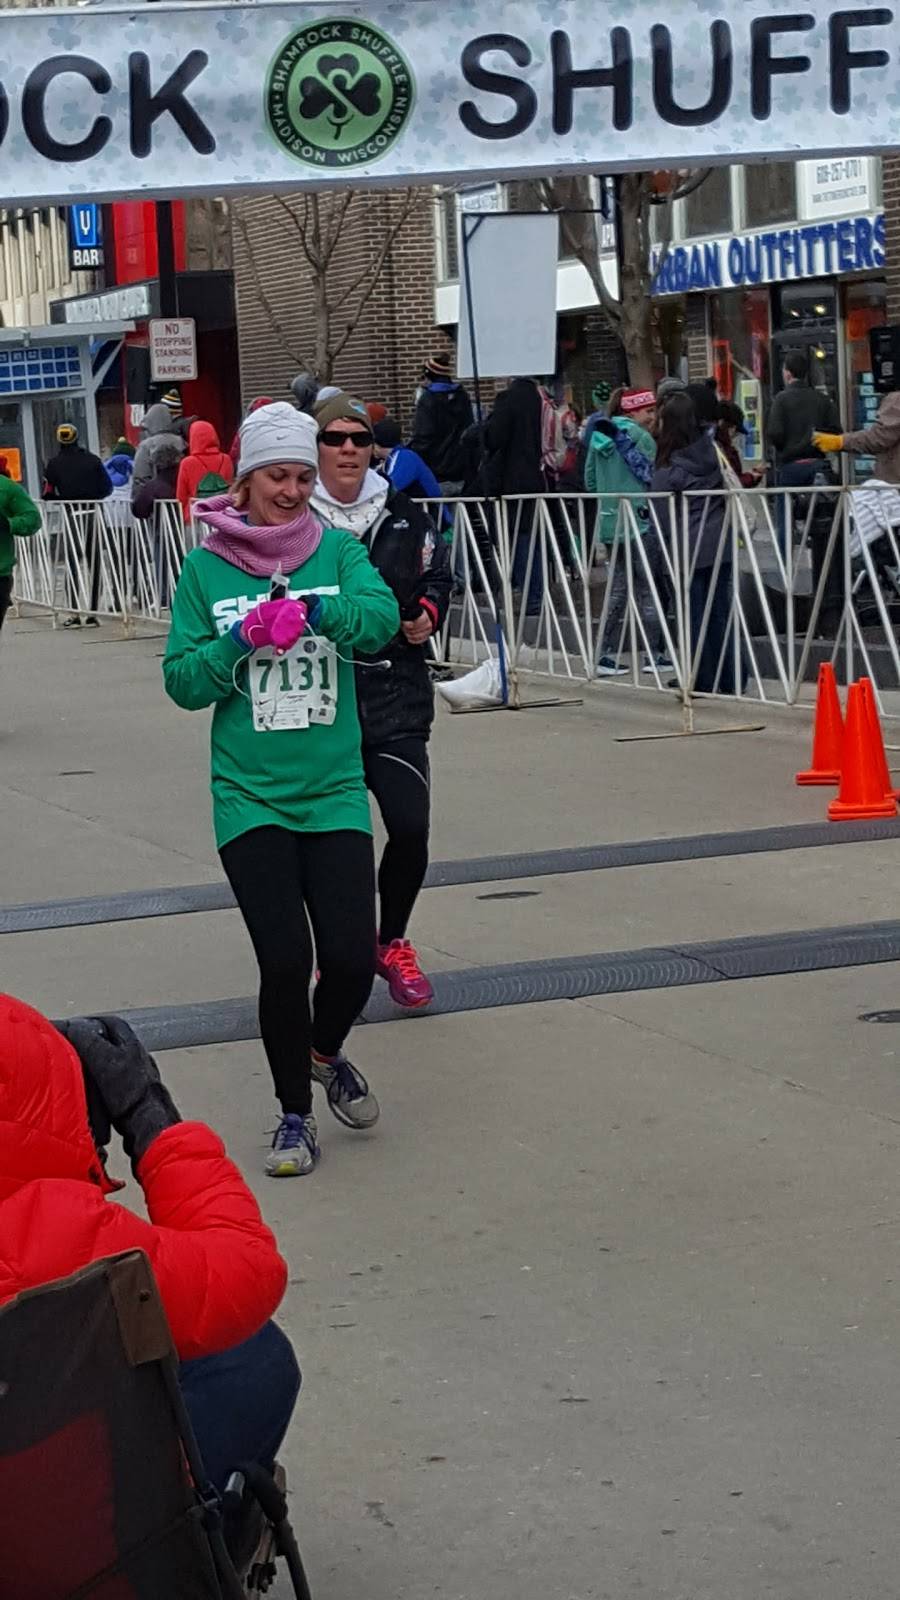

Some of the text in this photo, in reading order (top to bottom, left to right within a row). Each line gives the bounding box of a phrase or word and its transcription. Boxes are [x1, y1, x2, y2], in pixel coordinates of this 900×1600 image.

[273, 26, 408, 92] SHAMROCK SHUFFLE
[0, 8, 894, 163] CK SHUFF
[272, 97, 407, 163] MADISON WISCONSIN
[73, 249, 99, 266] BAR
[728, 214, 886, 285] OUTFITTERS
[154, 336, 192, 347] STOPPING
[165, 323, 180, 336] NO
[155, 347, 192, 358] STANDING
[157, 364, 192, 375] PARKING
[256, 656, 331, 694] 7131
